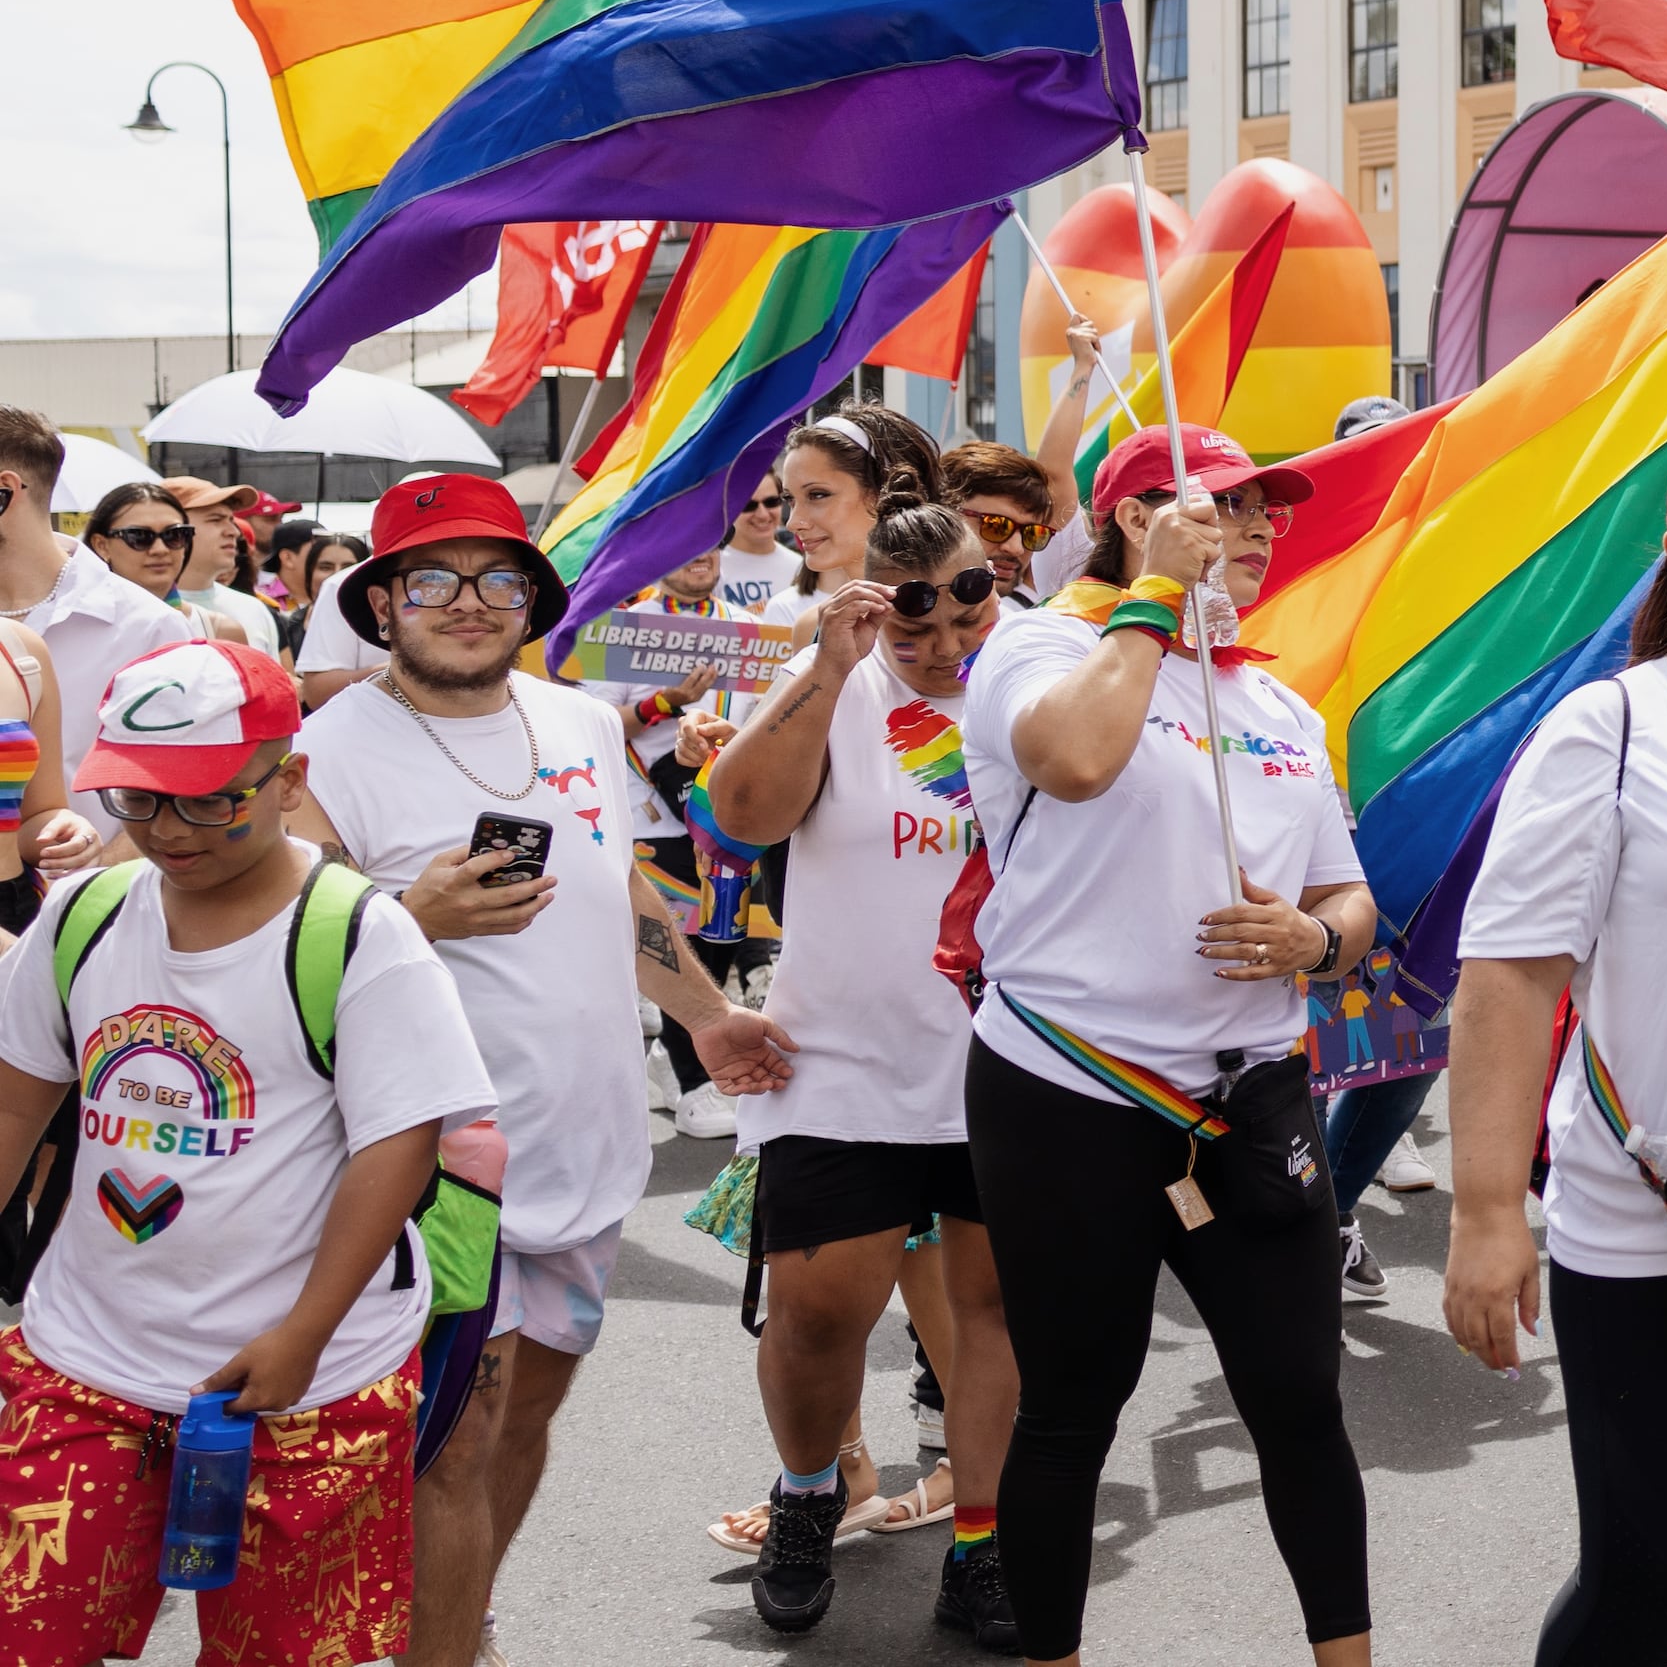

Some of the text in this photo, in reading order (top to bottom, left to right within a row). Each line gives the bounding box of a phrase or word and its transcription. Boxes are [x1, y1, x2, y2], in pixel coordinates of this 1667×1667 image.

[724, 581, 773, 607] NOT
[584, 624, 663, 648] LIBRES
[665, 631, 697, 651] DE
[100, 1011, 243, 1079] DARE
[118, 1078, 193, 1109] TO BE
